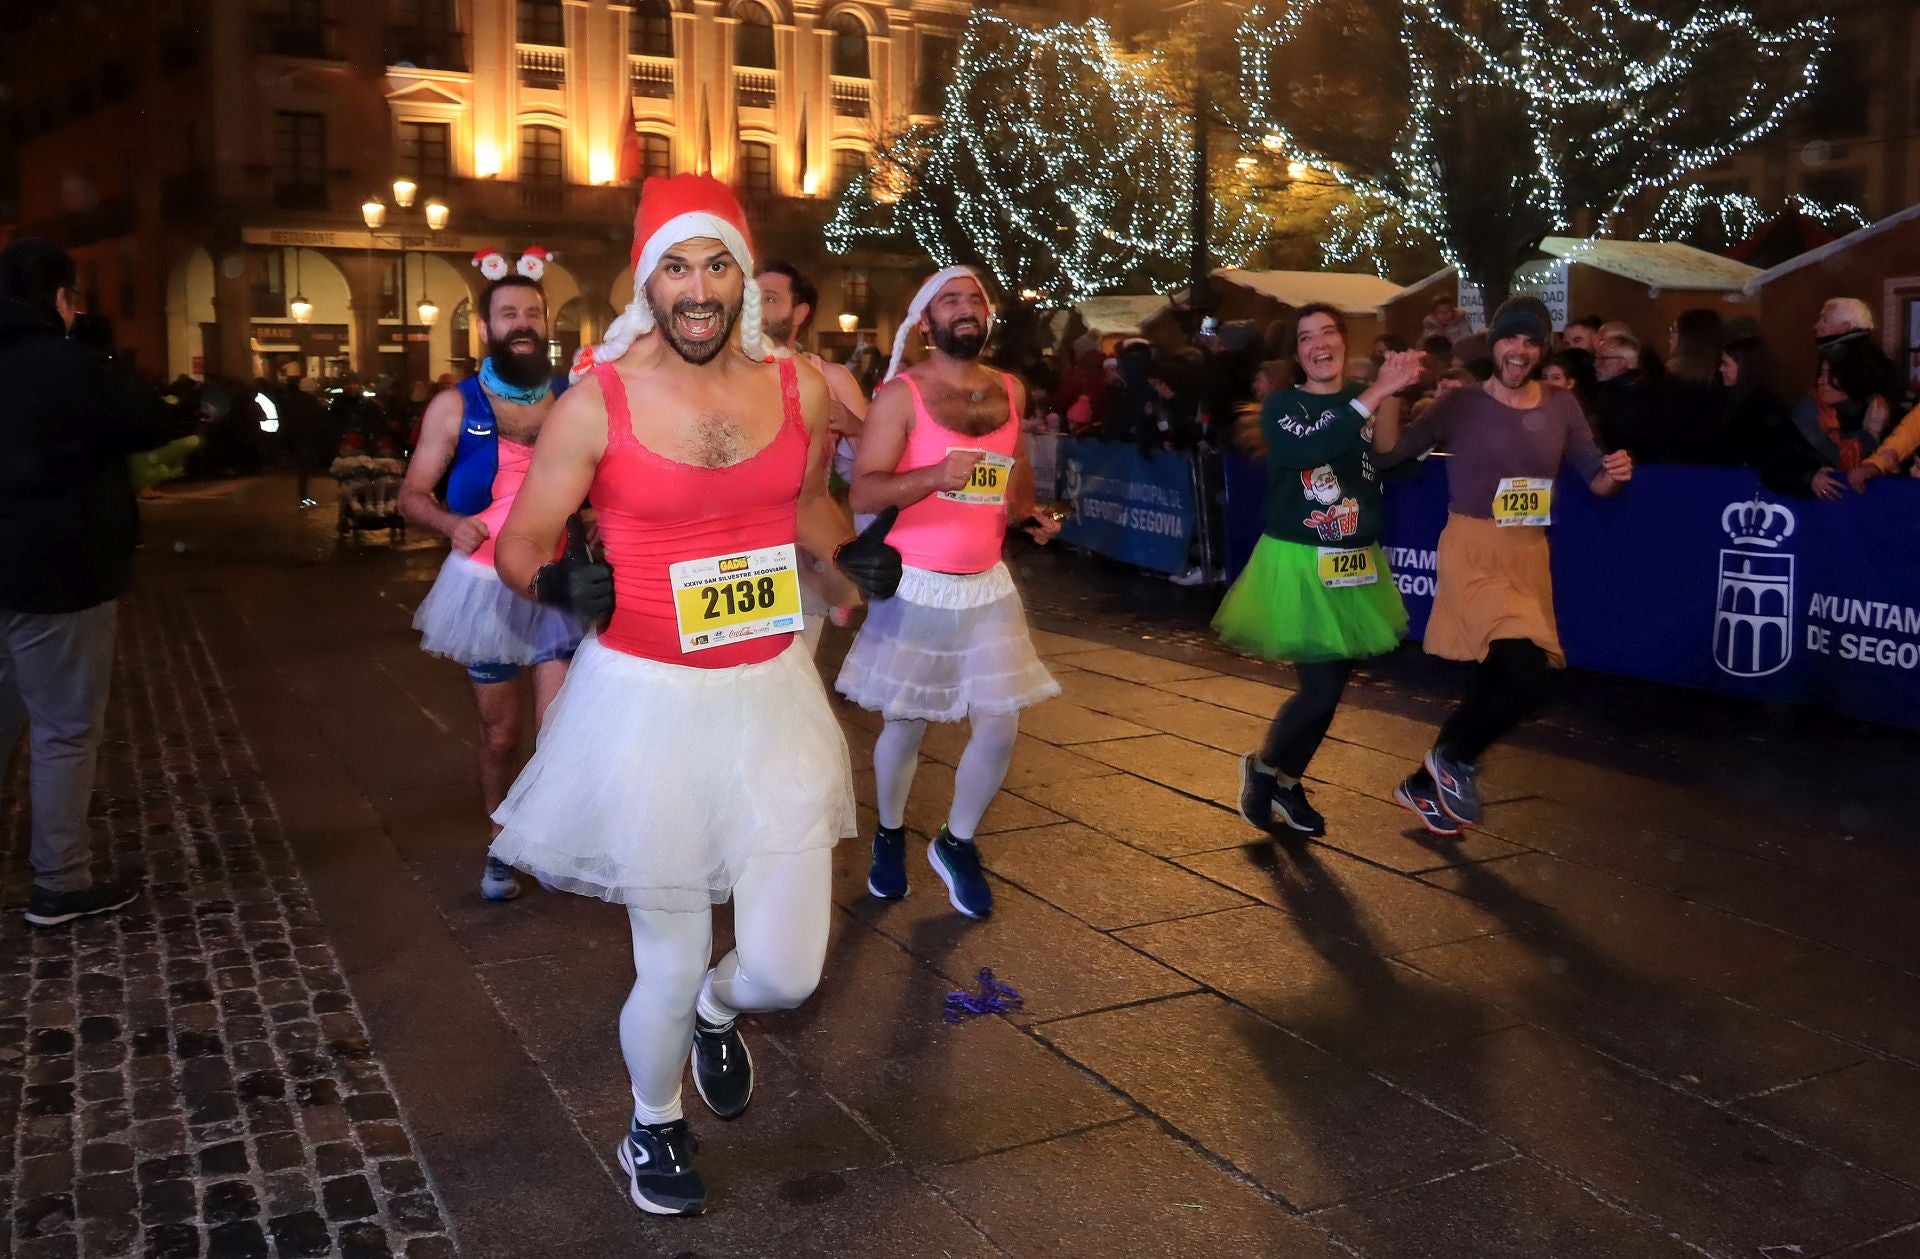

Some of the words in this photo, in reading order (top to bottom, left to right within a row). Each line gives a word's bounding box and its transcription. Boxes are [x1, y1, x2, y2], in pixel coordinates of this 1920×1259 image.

[971, 466, 997, 488] 136
[1501, 492, 1539, 512] 1239
[1129, 507, 1184, 539] SEGOVIA
[1331, 552, 1367, 574] 1240
[683, 580, 703, 589] XXXIV
[704, 577, 717, 585] SAN
[718, 571, 752, 582] SILVESTRE
[753, 565, 788, 577] SEGOVIANA
[701, 576, 775, 620] 2138
[1807, 624, 1831, 655] DE
[1838, 633, 1920, 669] SEGO
